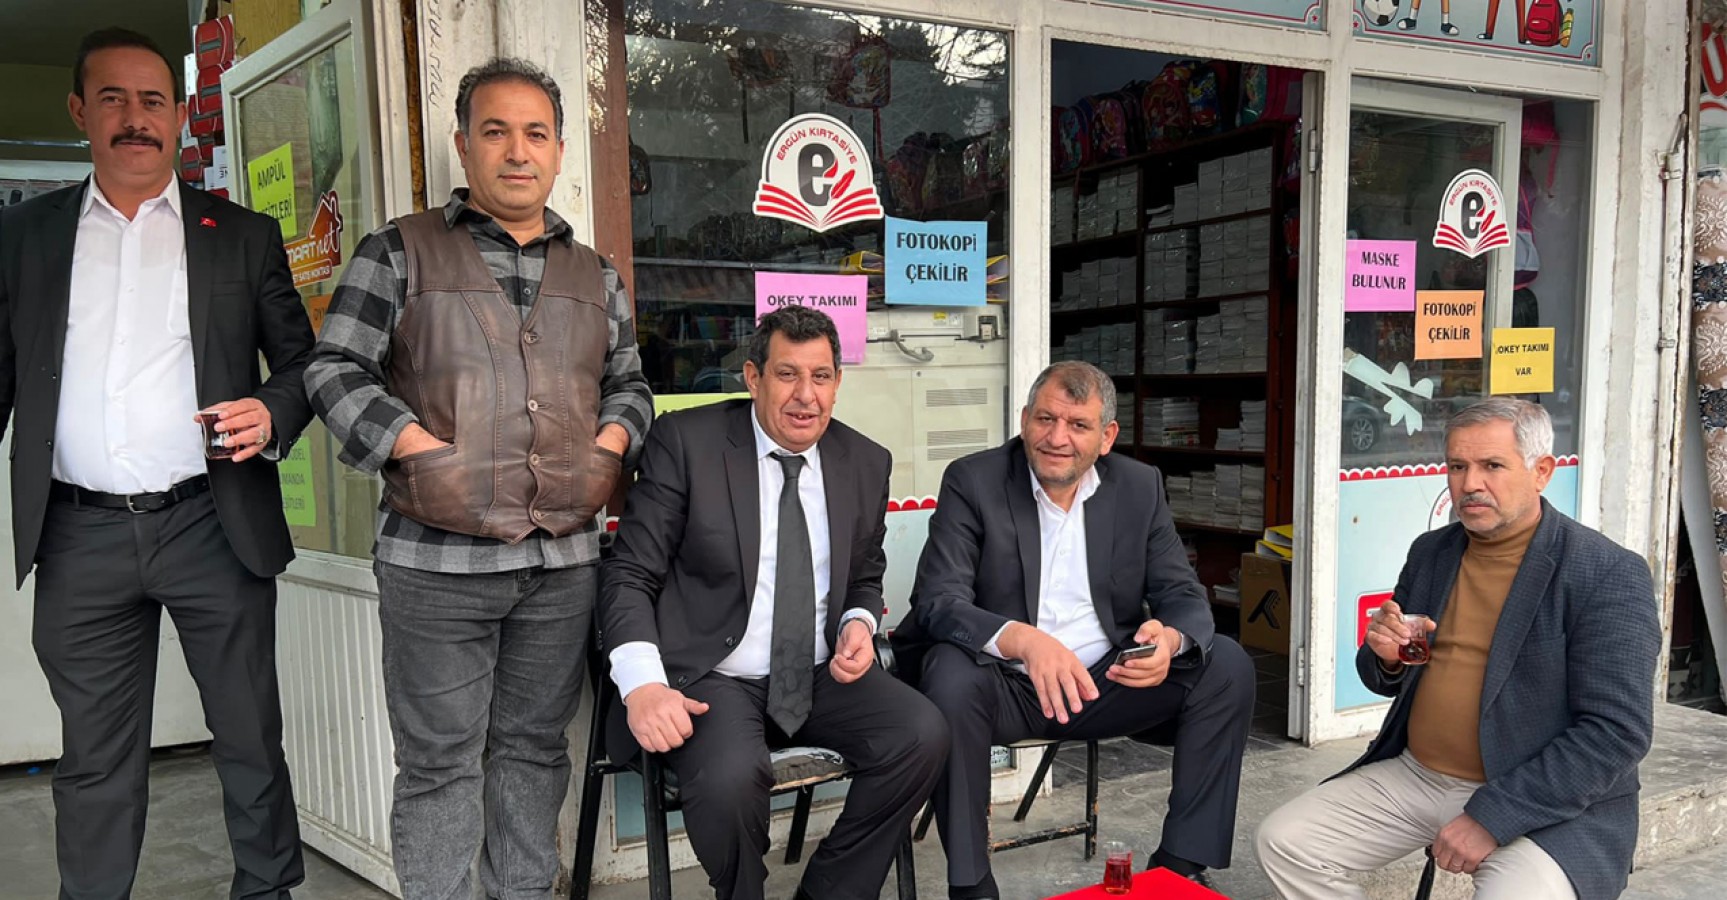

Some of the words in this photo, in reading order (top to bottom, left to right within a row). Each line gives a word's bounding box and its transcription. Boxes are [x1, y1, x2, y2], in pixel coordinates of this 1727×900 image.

[776, 129, 806, 161] ERGÜN
[809, 127, 858, 164] KIRTASİYE
[257, 158, 286, 190] AMPÜL
[896, 232, 977, 252] FOTOKOPİ
[1361, 251, 1400, 267] MASKE
[906, 262, 968, 285] ÇEKİLİR
[1352, 274, 1407, 290] BULUNUR
[767, 295, 804, 307] OKEY
[809, 295, 857, 307] TAKIMI
[1423, 301, 1477, 317] FOTOKOPİ
[1428, 325, 1471, 343] ÇEKİLİR
[1498, 345, 1520, 354] OKEY
[1522, 343, 1549, 353] TAKIMI
[1515, 367, 1532, 376] VAR
